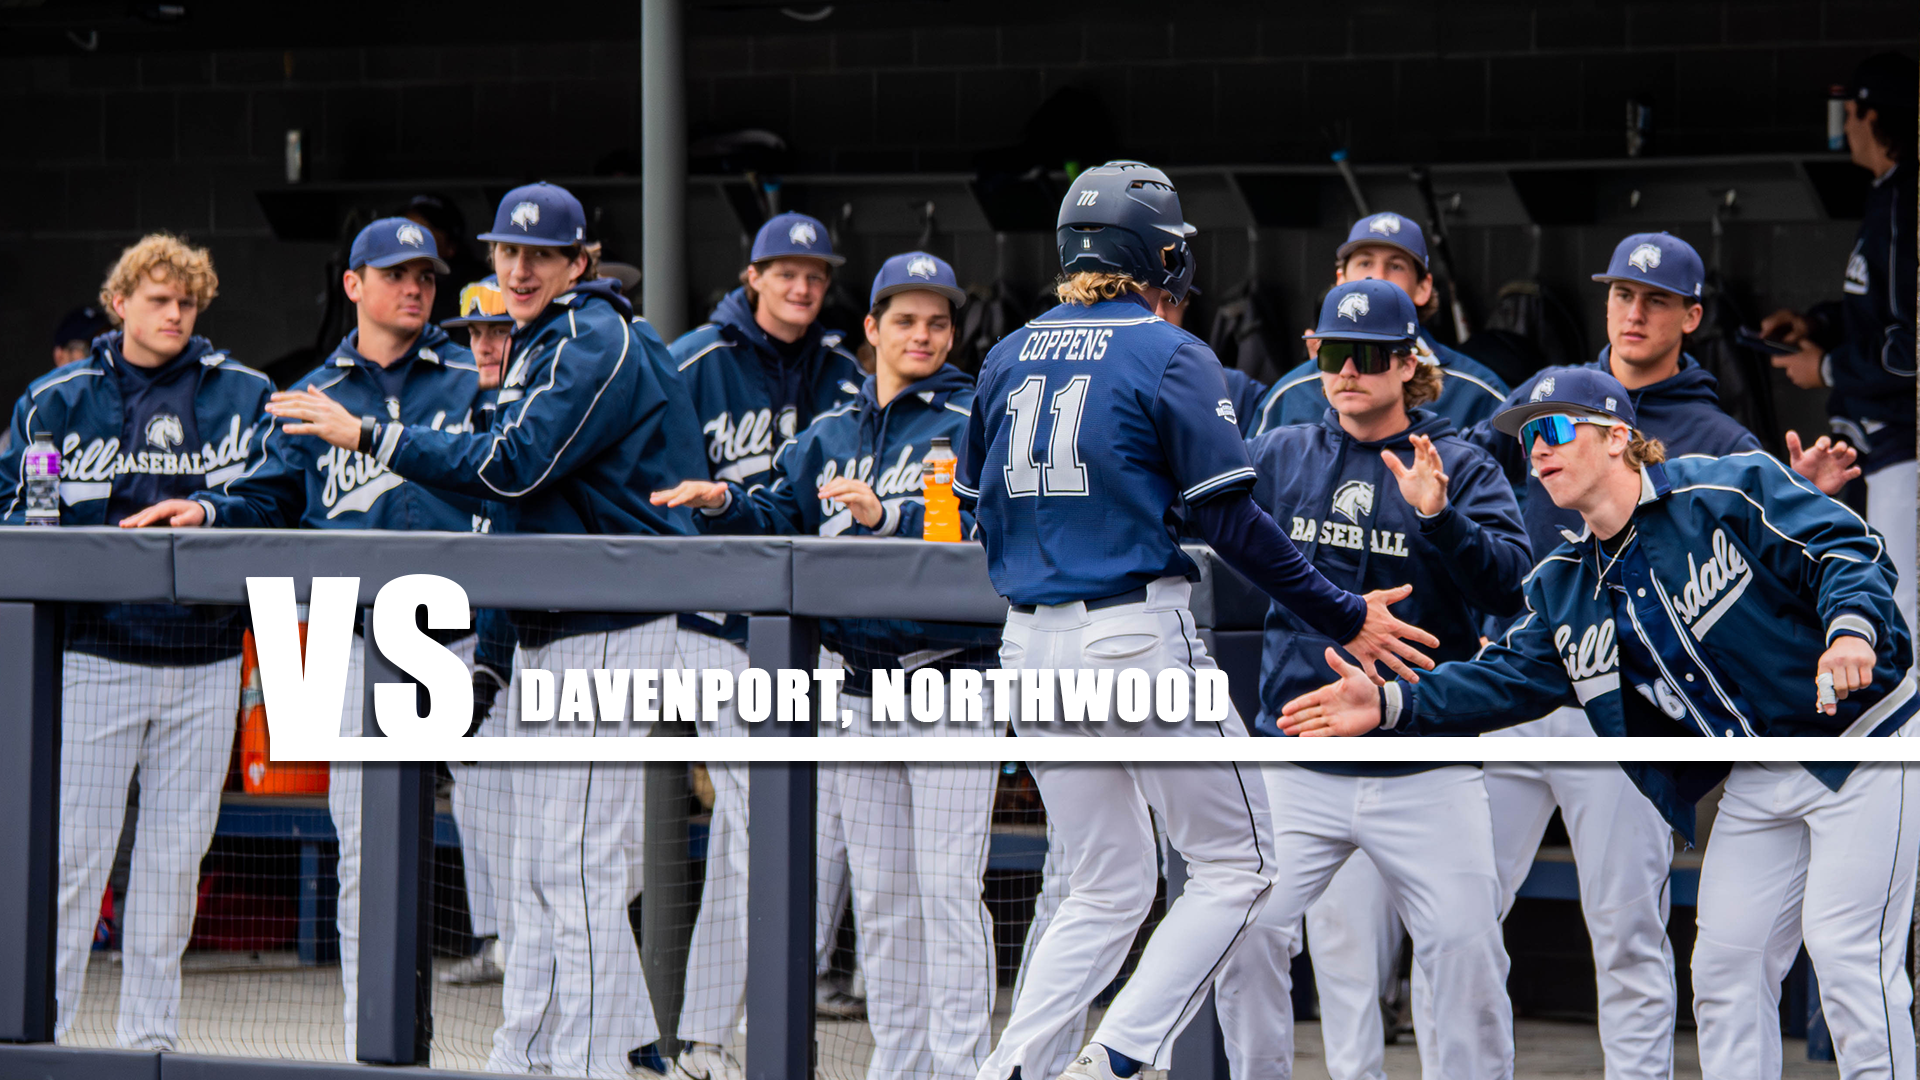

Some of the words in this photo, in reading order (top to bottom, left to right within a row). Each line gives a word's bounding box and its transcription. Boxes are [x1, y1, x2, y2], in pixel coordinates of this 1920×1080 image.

[1083, 237, 1091, 249] 11
[1018, 328, 1113, 361] COPPENS
[1003, 375, 1091, 498] 11
[114, 451, 206, 475] BASEBAL
[1290, 516, 1409, 557] BASEBALL
